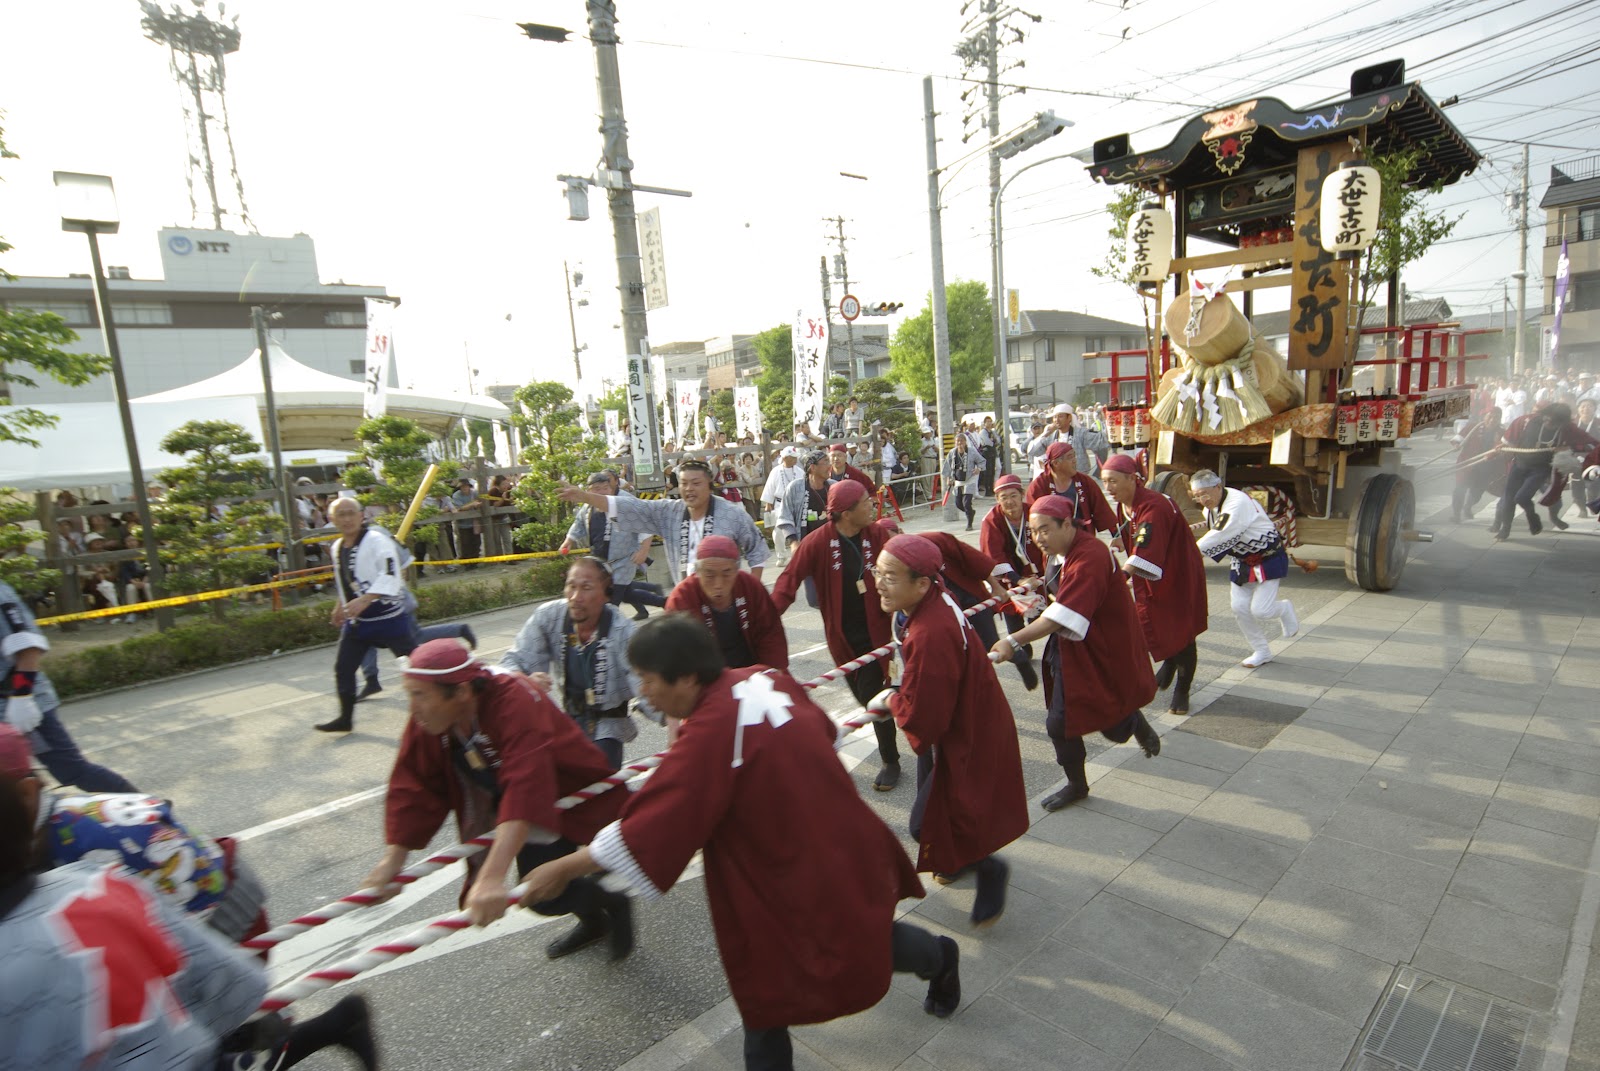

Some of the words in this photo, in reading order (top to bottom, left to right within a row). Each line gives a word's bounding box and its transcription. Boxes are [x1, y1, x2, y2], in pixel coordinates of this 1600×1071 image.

[1335, 169, 1368, 246] 大世古町
[197, 240, 230, 253] NTT
[1132, 212, 1154, 276] 大世古町
[845, 302, 856, 314] 40
[1339, 408, 1348, 442] 大世古町
[1361, 404, 1370, 438] 大世古町
[1382, 402, 1394, 437] 大世古町
